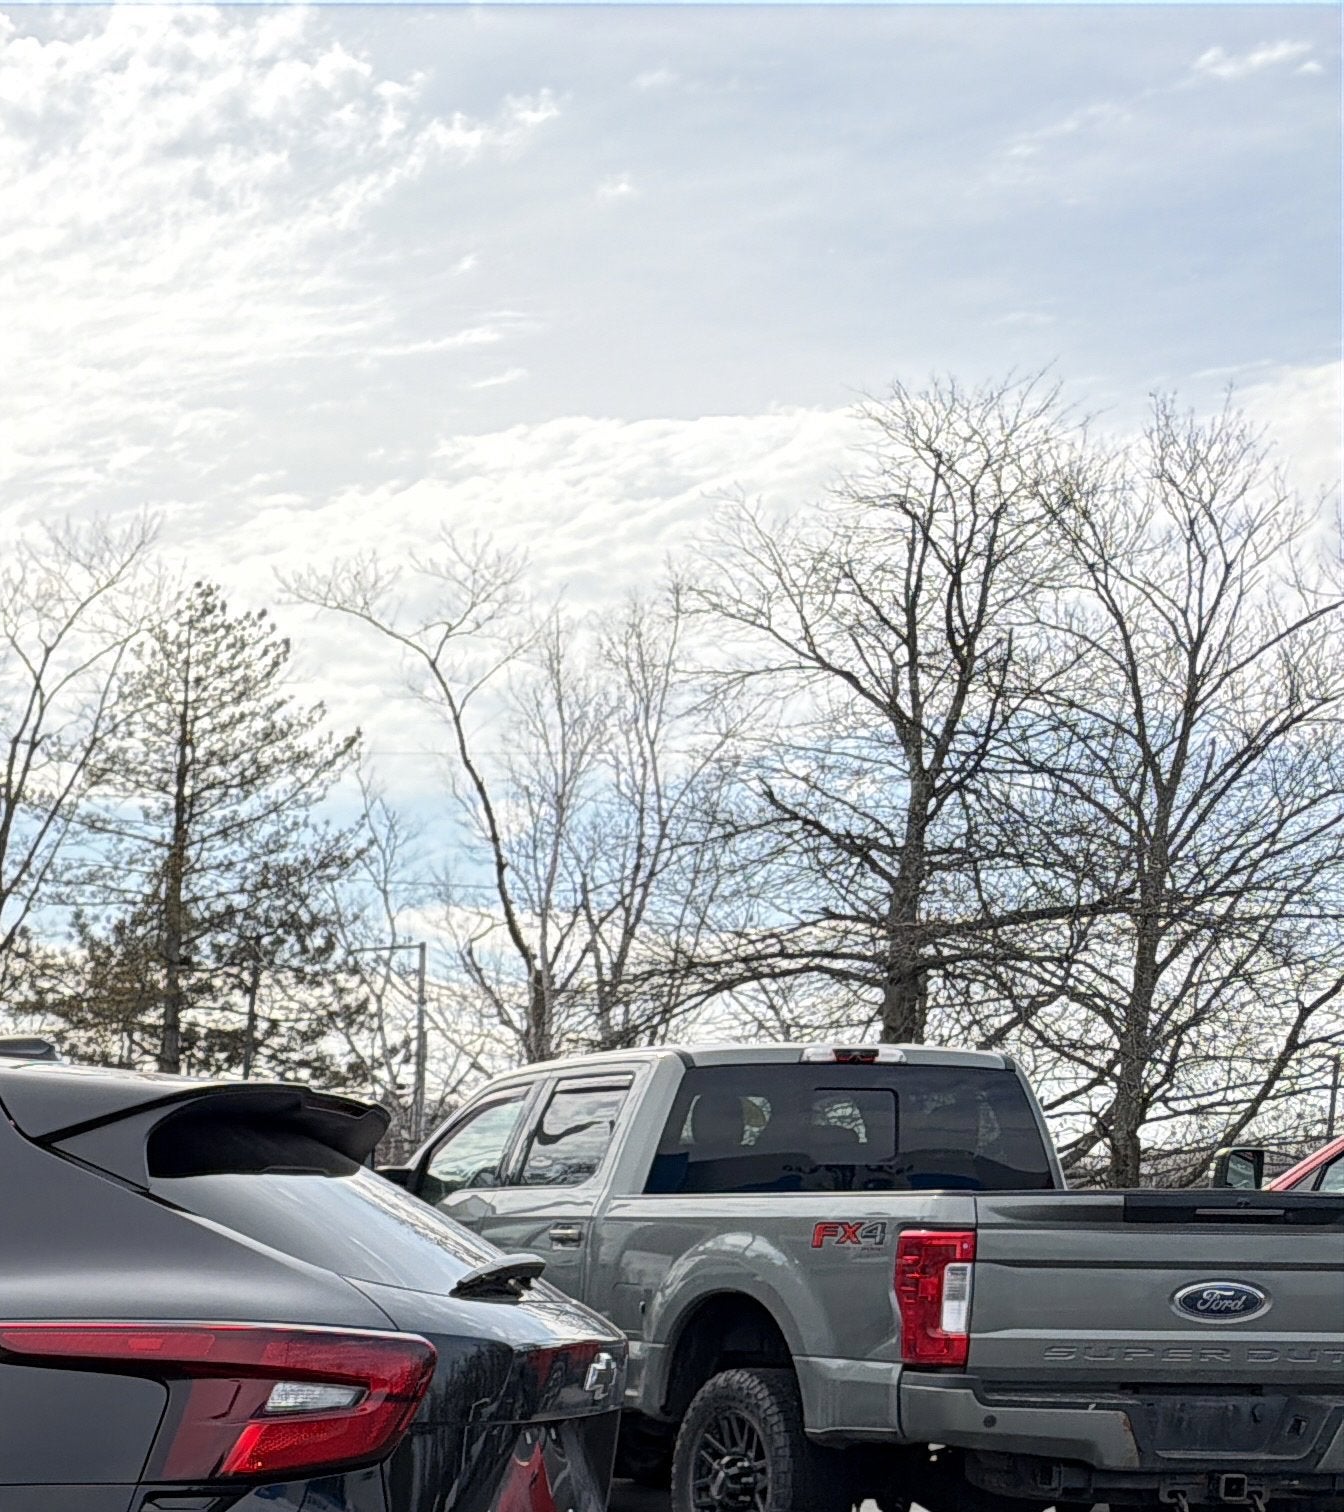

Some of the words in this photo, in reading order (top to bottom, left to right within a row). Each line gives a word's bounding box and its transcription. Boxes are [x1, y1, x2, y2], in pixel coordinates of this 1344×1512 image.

[811, 1221, 887, 1249] FX4
[1196, 1289, 1248, 1311] Ford
[1042, 1345, 1231, 1362] SUPER
